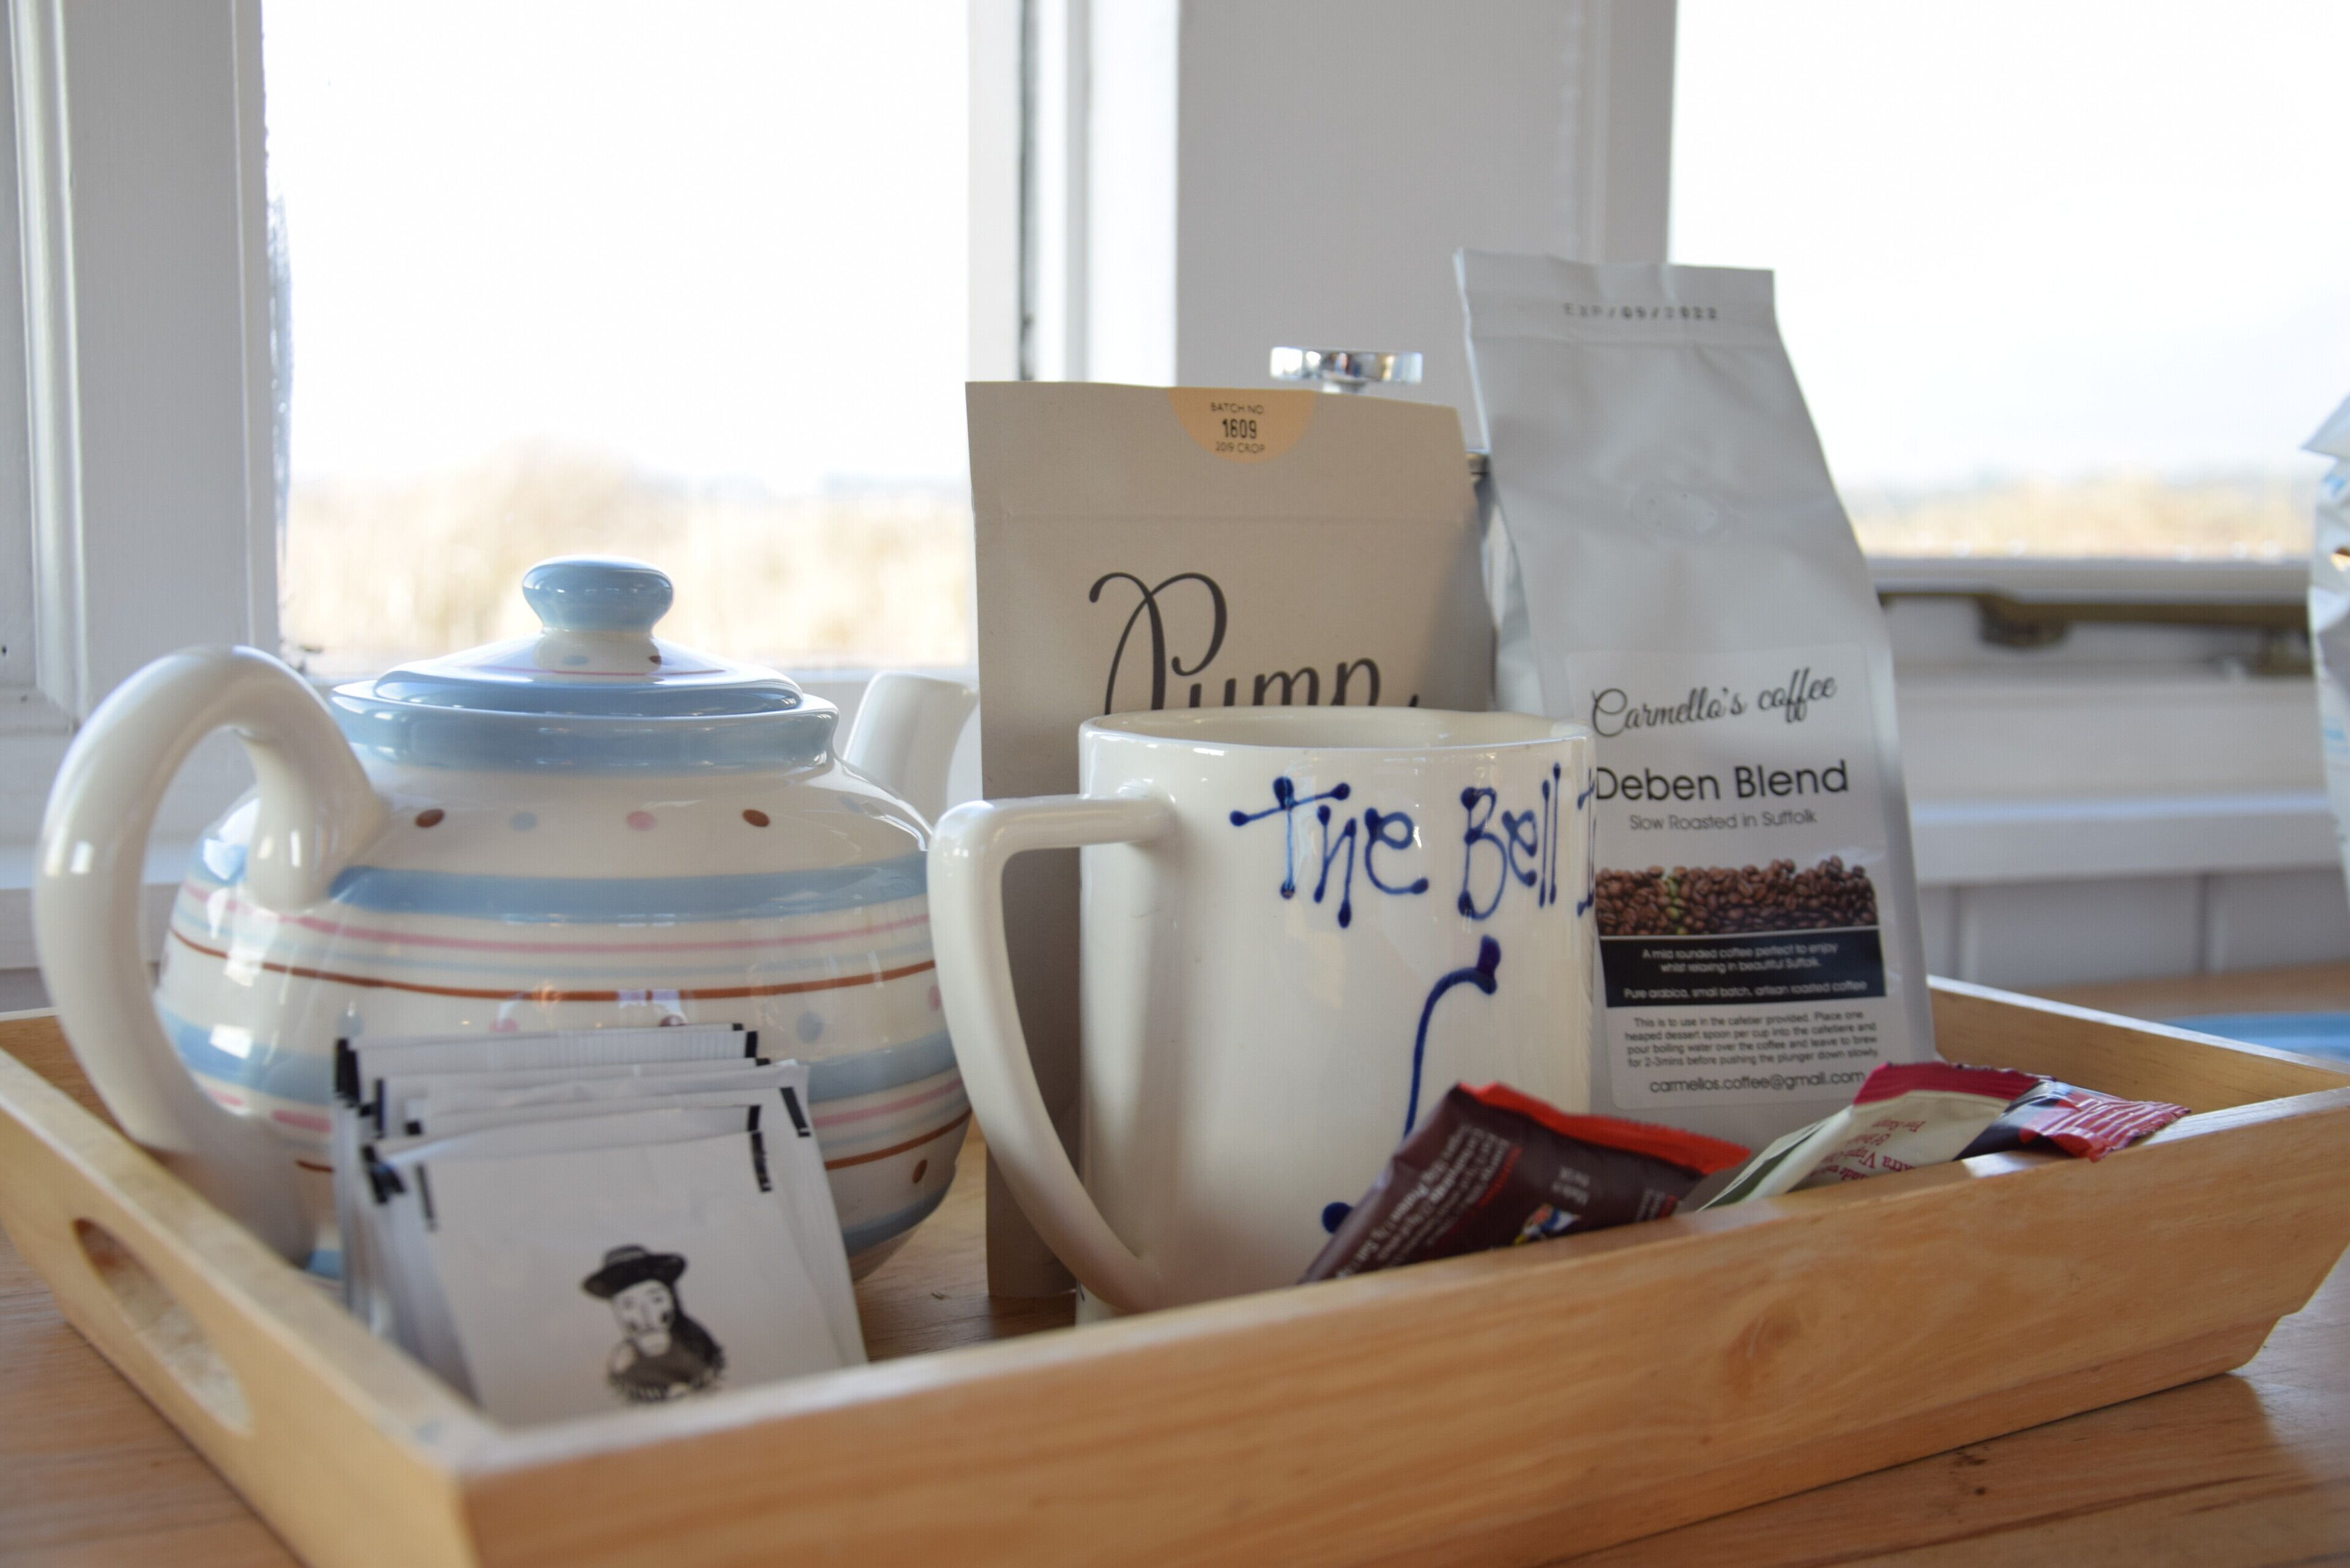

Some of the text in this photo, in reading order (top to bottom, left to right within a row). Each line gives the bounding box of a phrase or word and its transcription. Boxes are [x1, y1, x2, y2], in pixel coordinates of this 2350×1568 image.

[1211, 402, 1264, 414] BATCH NO
[1223, 419, 1257, 439] 1609
[1216, 441, 1265, 454] 2019 CROP
[1592, 668, 1837, 737] Carmello's coffee
[1597, 760, 1849, 801] Deben Blend
[1630, 811, 1818, 829] Slow Roasted in Suffolk
[1229, 776, 1430, 928] The
[1458, 762, 1561, 920] Bell
[1642, 943, 1838, 959] A mild rounded coffee perfect to enjoy
[1661, 963, 1686, 973] whilst
[1688, 963, 1726, 974] relaxing
[1728, 963, 1737, 971] in
[1739, 960, 1784, 971] beautiful
[1623, 988, 1647, 999] Pure
[1692, 988, 1718, 998] small
[1754, 985, 1789, 996] artisan
[1791, 982, 1830, 994] roasted
[1832, 980, 1868, 992] coffee
[1635, 1017, 1655, 1027] This
[1657, 1018, 1666, 1027] is
[1668, 1018, 1677, 1026] to
[1710, 1017, 1725, 1025] the
[1814, 1011, 1842, 1021] Place
[1845, 1011, 1863, 1020] one
[1625, 1032, 1663, 1042] heaped
[1665, 1031, 1700, 1040] dessert
[1703, 1031, 1731, 1040] spoon
[1734, 1030, 1748, 1040] per
[1752, 1029, 1769, 1039] cup
[1772, 1027, 1790, 1036] into
[1792, 1026, 1808, 1035] the
[1858, 1022, 1877, 1031] and
[1627, 1046, 1649, 1056] pour
[1653, 1043, 1684, 1055] boiling
[1688, 1043, 1713, 1051] water
[1739, 1042, 1754, 1050] the
[1756, 1040, 1786, 1050] coffee
[1789, 1039, 1808, 1048] and
[1811, 1037, 1838, 1047] leave
[1840, 1037, 1851, 1045] to
[1852, 1035, 1877, 1045] brew
[1628, 1058, 1642, 1068] for
[1687, 1055, 1716, 1066] before
[1719, 1053, 1756, 1065] pushing
[1759, 1054, 1774, 1062] the
[1777, 1051, 1815, 1063] plunger
[1818, 1050, 1846, 1059] down
